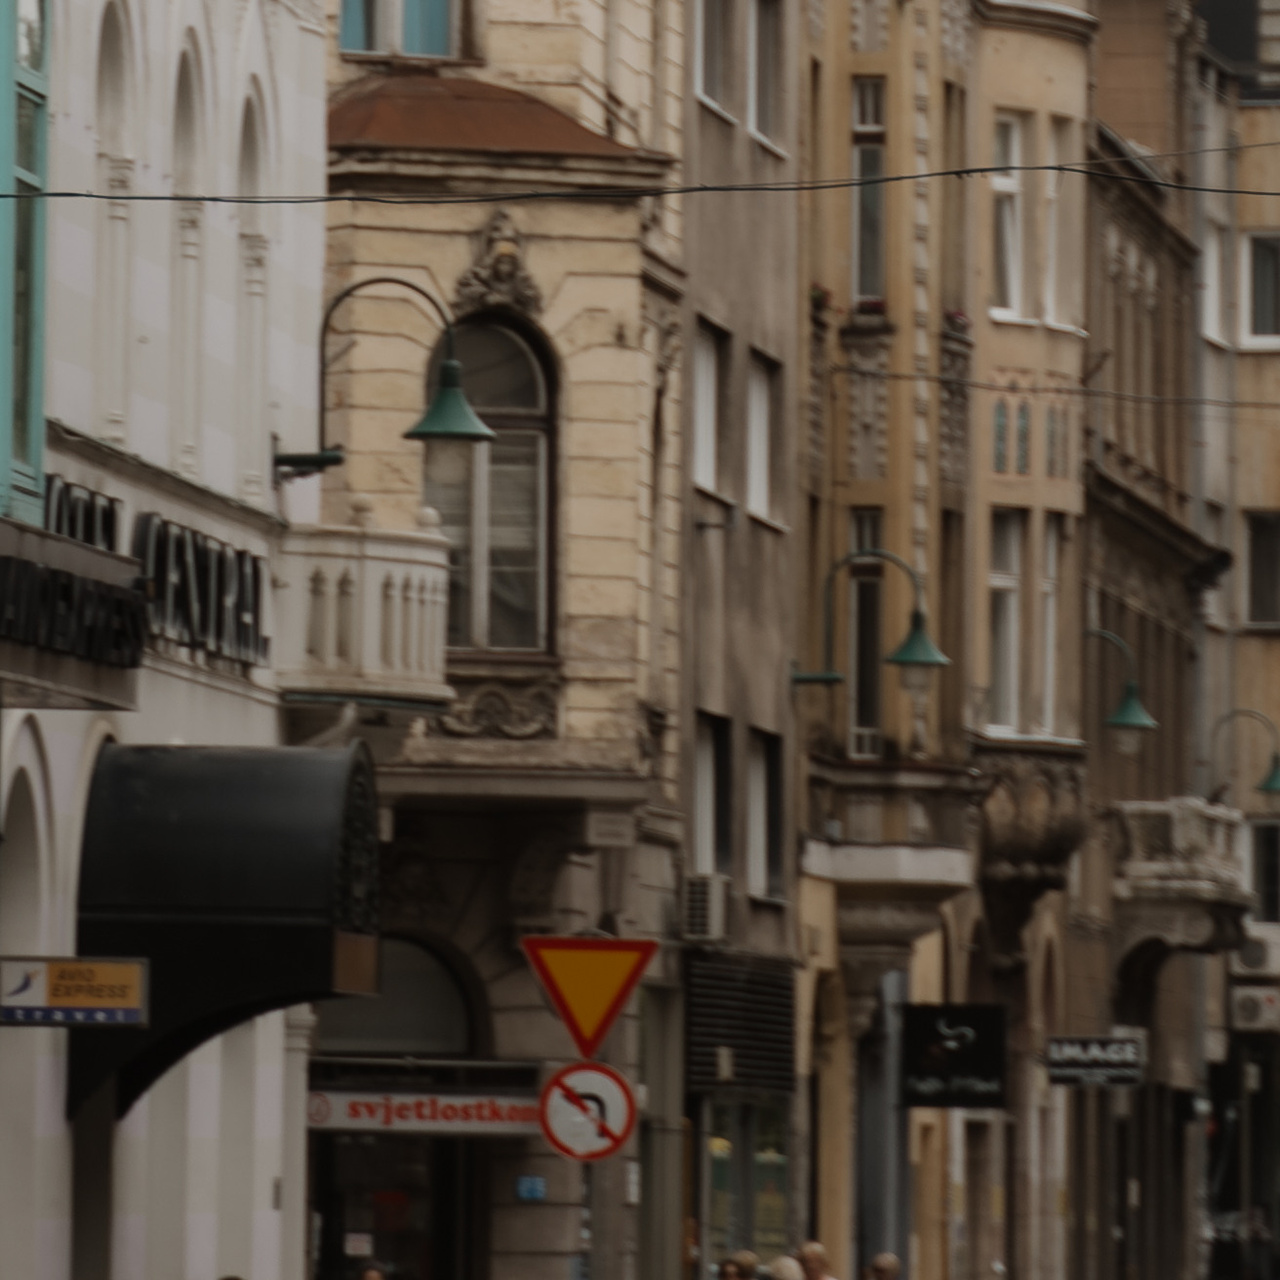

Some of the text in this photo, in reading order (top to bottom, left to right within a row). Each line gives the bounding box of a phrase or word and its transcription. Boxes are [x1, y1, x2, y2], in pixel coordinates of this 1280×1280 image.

[133, 512, 271, 666] CENTRAL
[51, 983, 131, 998] EXPRESS
[15, 1009, 125, 1021] travel
[1049, 1041, 1138, 1062] IMAGE
